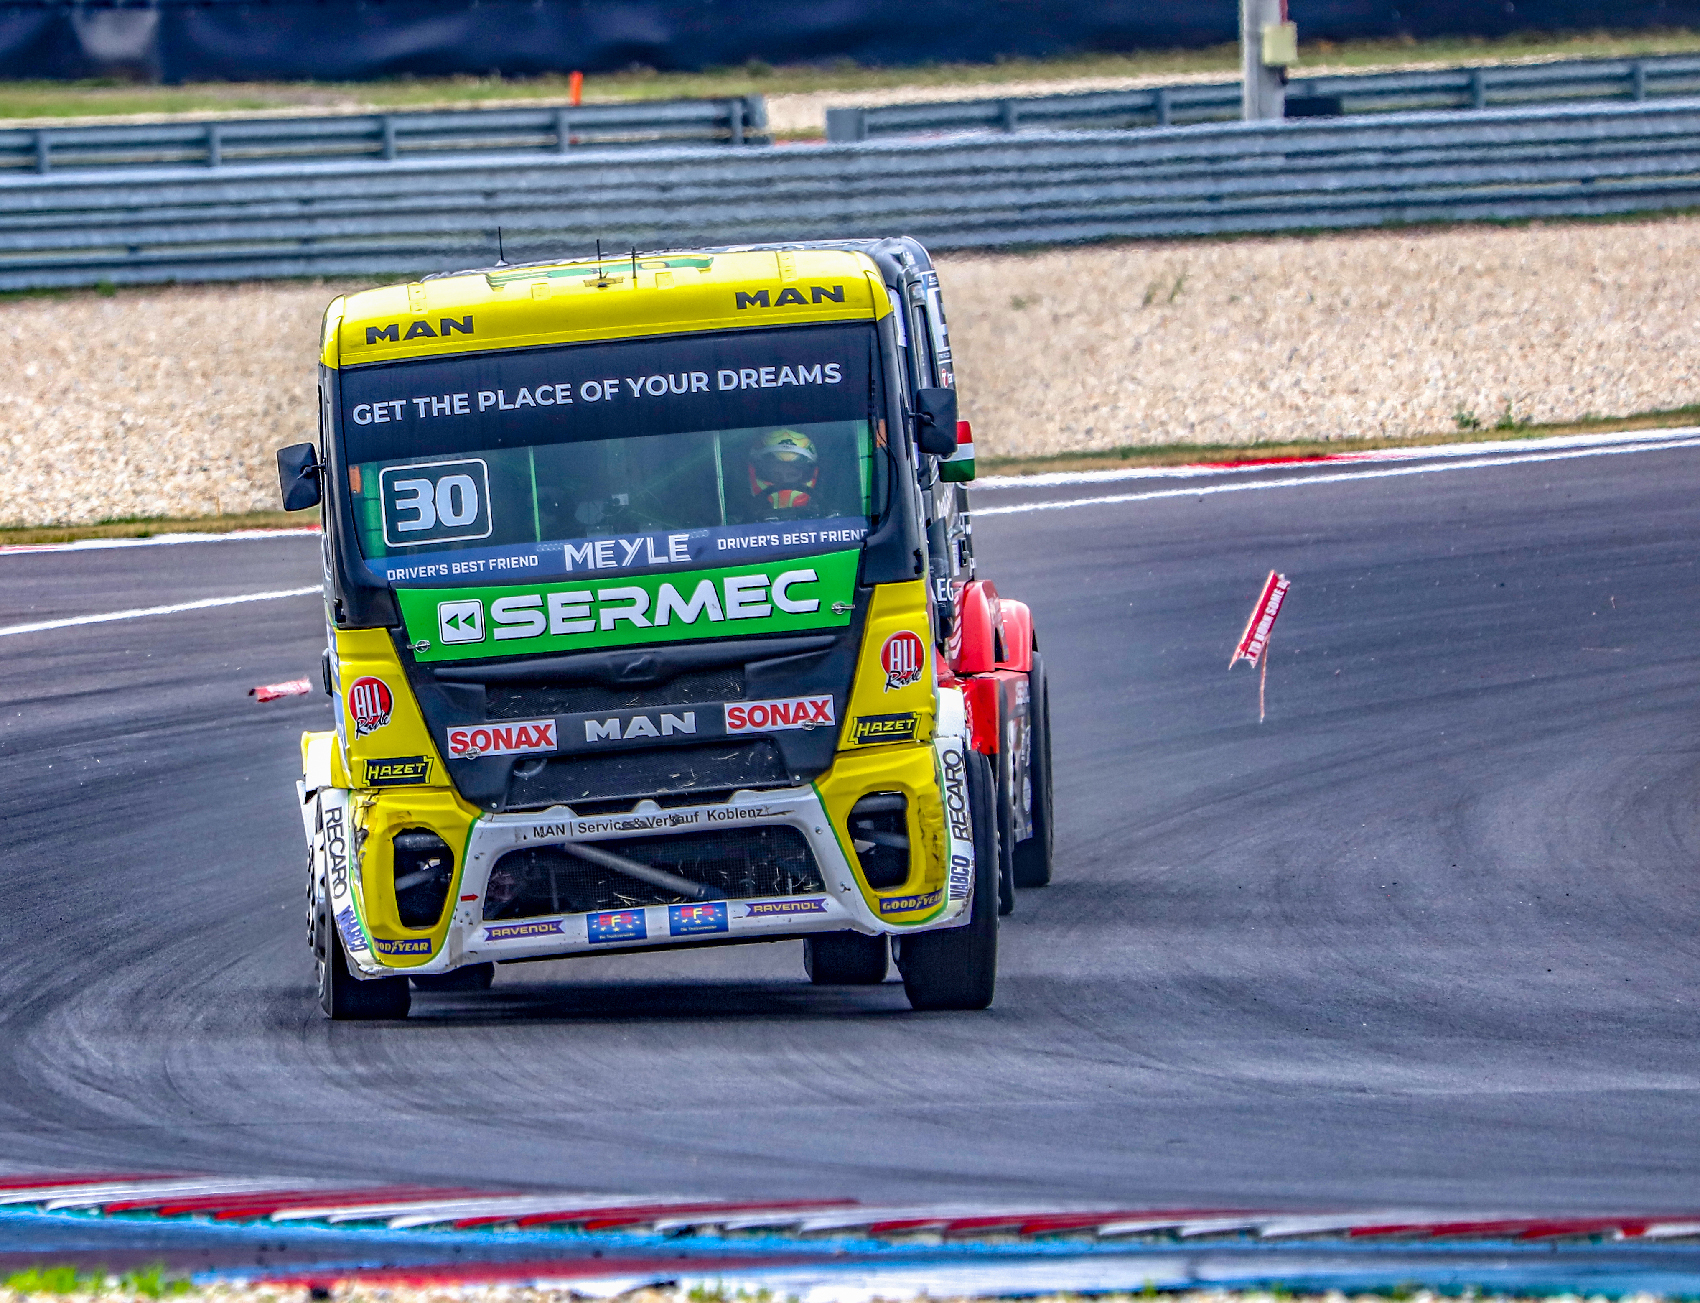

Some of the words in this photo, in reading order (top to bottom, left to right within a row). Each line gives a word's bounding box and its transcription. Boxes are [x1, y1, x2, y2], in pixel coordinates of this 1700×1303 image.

[735, 284, 845, 310] MAN
[365, 315, 475, 345] MAN
[353, 399, 407, 425] GET
[412, 392, 471, 418] THE
[477, 383, 573, 412] PLACE
[580, 379, 620, 402] OF
[626, 371, 710, 398] YOUR
[717, 362, 843, 391] DREAMS
[393, 474, 479, 532] 30
[563, 533, 692, 571] MEYLE
[717, 534, 780, 550] DRIVER'S
[783, 531, 818, 546] BEST
[386, 564, 449, 581] DRIVER'S
[452, 560, 487, 575] BEST
[488, 555, 539, 571] FRIEND
[490, 568, 820, 642] SERMEC
[584, 711, 696, 743] MAN
[726, 699, 832, 731] SONAX
[857, 719, 915, 738] HAZET
[449, 723, 555, 755] SONAX
[368, 763, 426, 780] HAZET
[942, 749, 972, 843] RECARO
[533, 823, 566, 838] MAN
[707, 807, 764, 822] Koblenz
[324, 806, 348, 900] RECARO
[949, 854, 971, 902] WABCO
[599, 912, 634, 927] BFS
[681, 905, 715, 920] BFS
[753, 901, 819, 914] RAVENOL
[491, 922, 557, 938] RAVENOL
